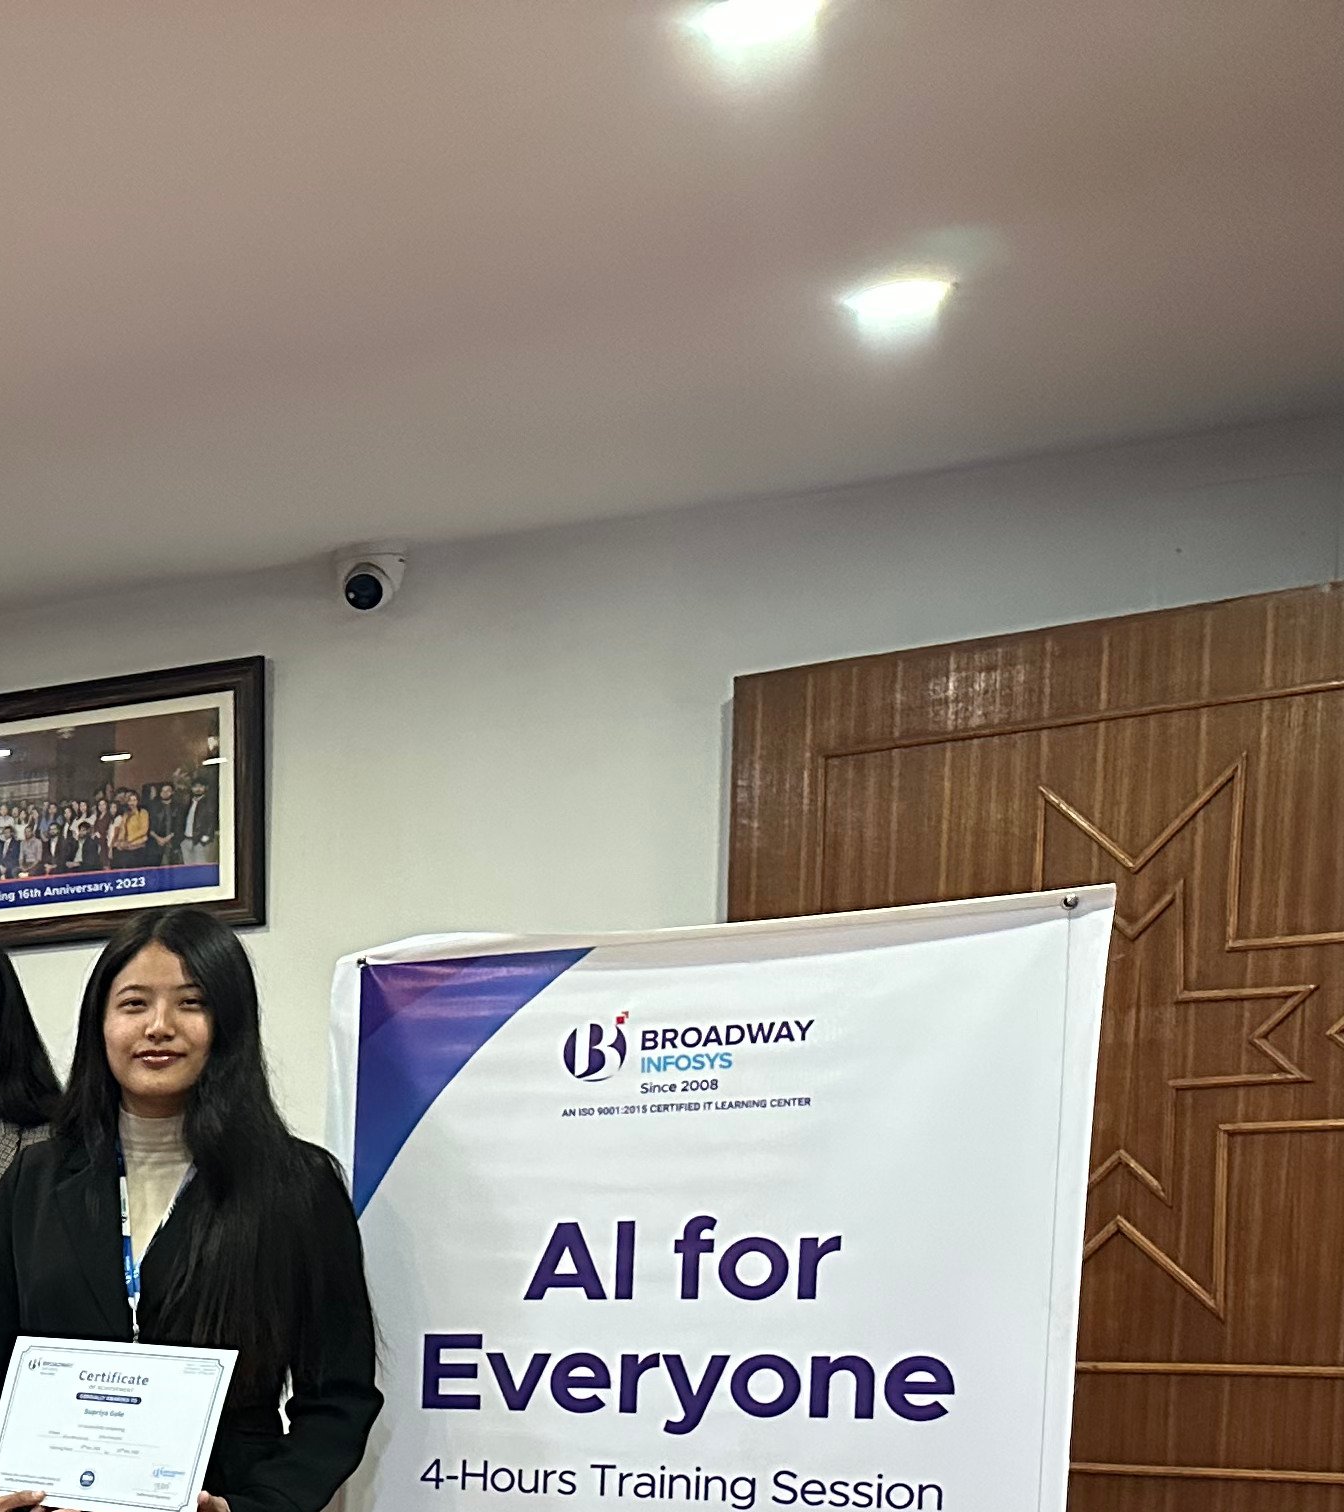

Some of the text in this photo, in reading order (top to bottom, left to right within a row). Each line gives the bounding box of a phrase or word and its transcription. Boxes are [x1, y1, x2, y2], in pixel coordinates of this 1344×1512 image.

[17, 888, 41, 900] 16th
[44, 882, 114, 897] Anniversary,
[116, 876, 146, 889] 2023
[640, 1020, 814, 1050] BROADWAY
[640, 1053, 732, 1073] INFOSYS
[640, 1079, 718, 1094] Since 2008
[562, 1098, 811, 1117] AN ISO 9001:2015 CERTIFIED IT LEARNING CENTER
[523, 1215, 842, 1300] AI for
[79, 1370, 149, 1386] Certificate
[421, 1334, 955, 1435] Everyone
[420, 1459, 943, 1511] 4-Hours Training Session
